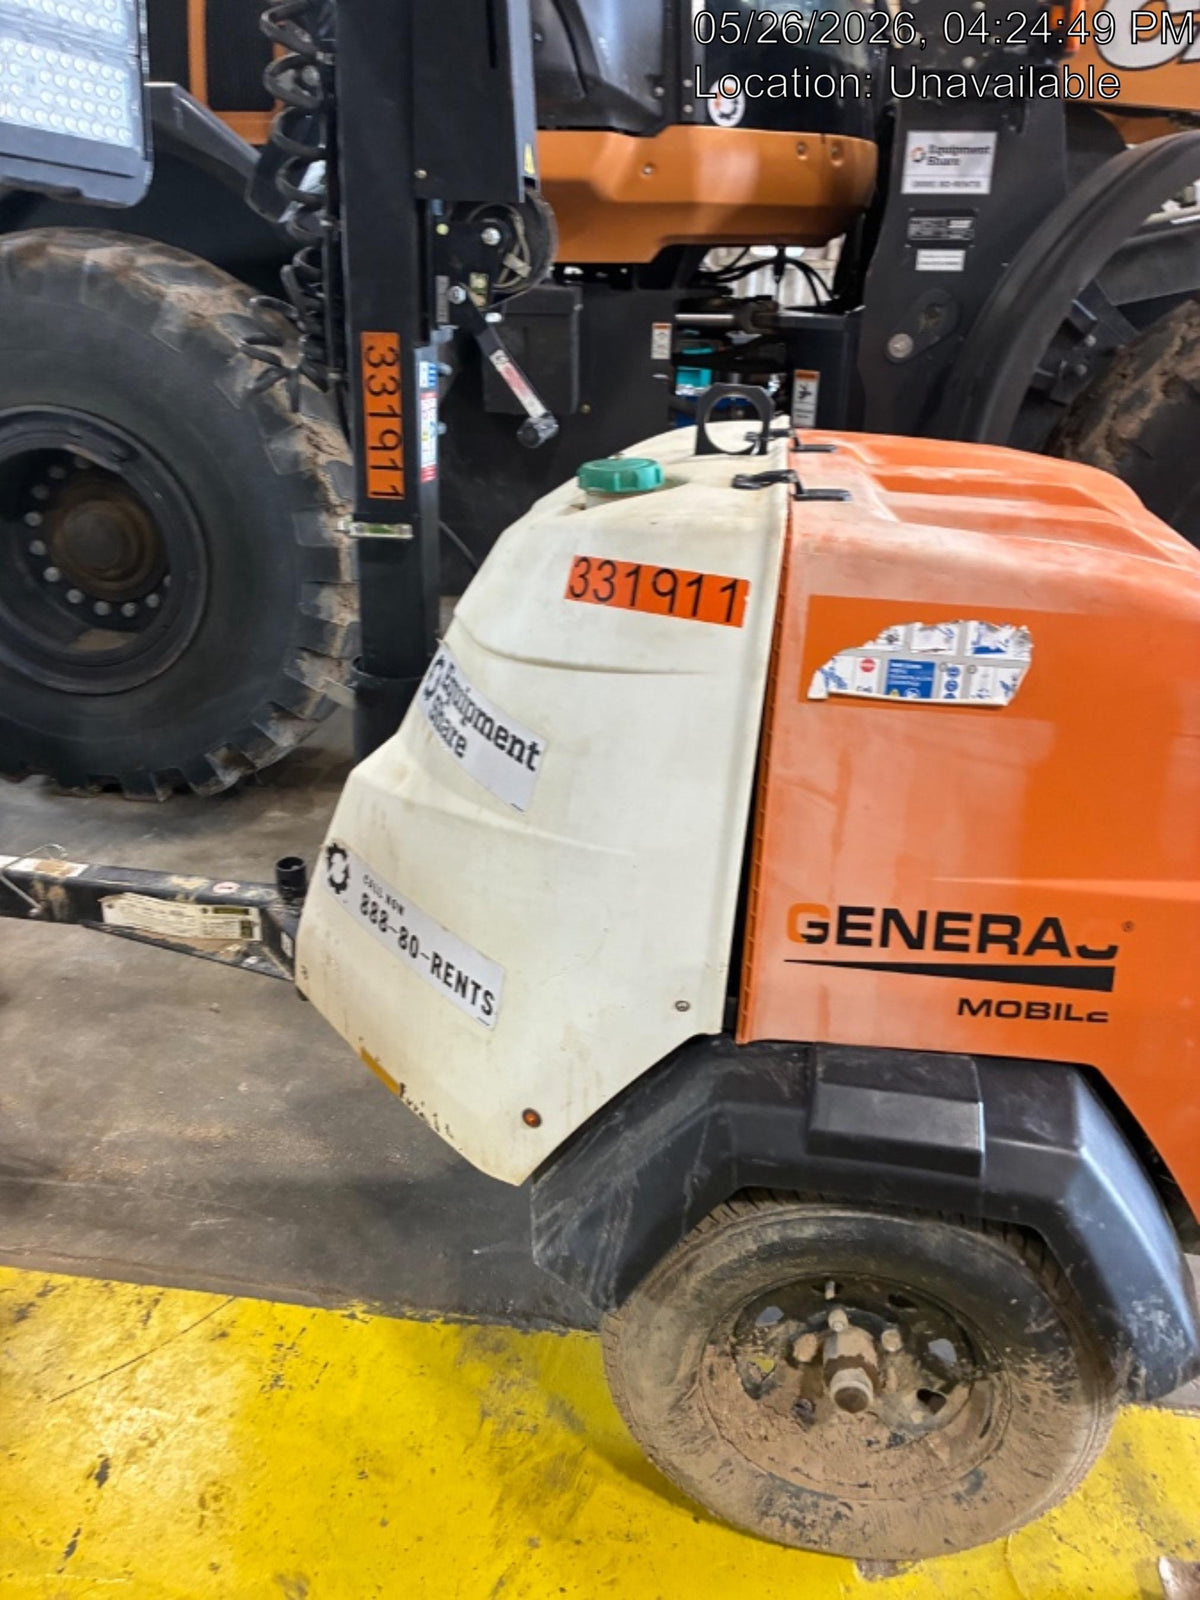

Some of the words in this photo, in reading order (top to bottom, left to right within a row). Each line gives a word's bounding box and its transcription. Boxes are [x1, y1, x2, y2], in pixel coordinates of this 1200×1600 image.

[366, 345, 404, 496] 331911
[569, 556, 738, 623] 331911
[360, 892, 495, 1016] 888-80-RENTS
